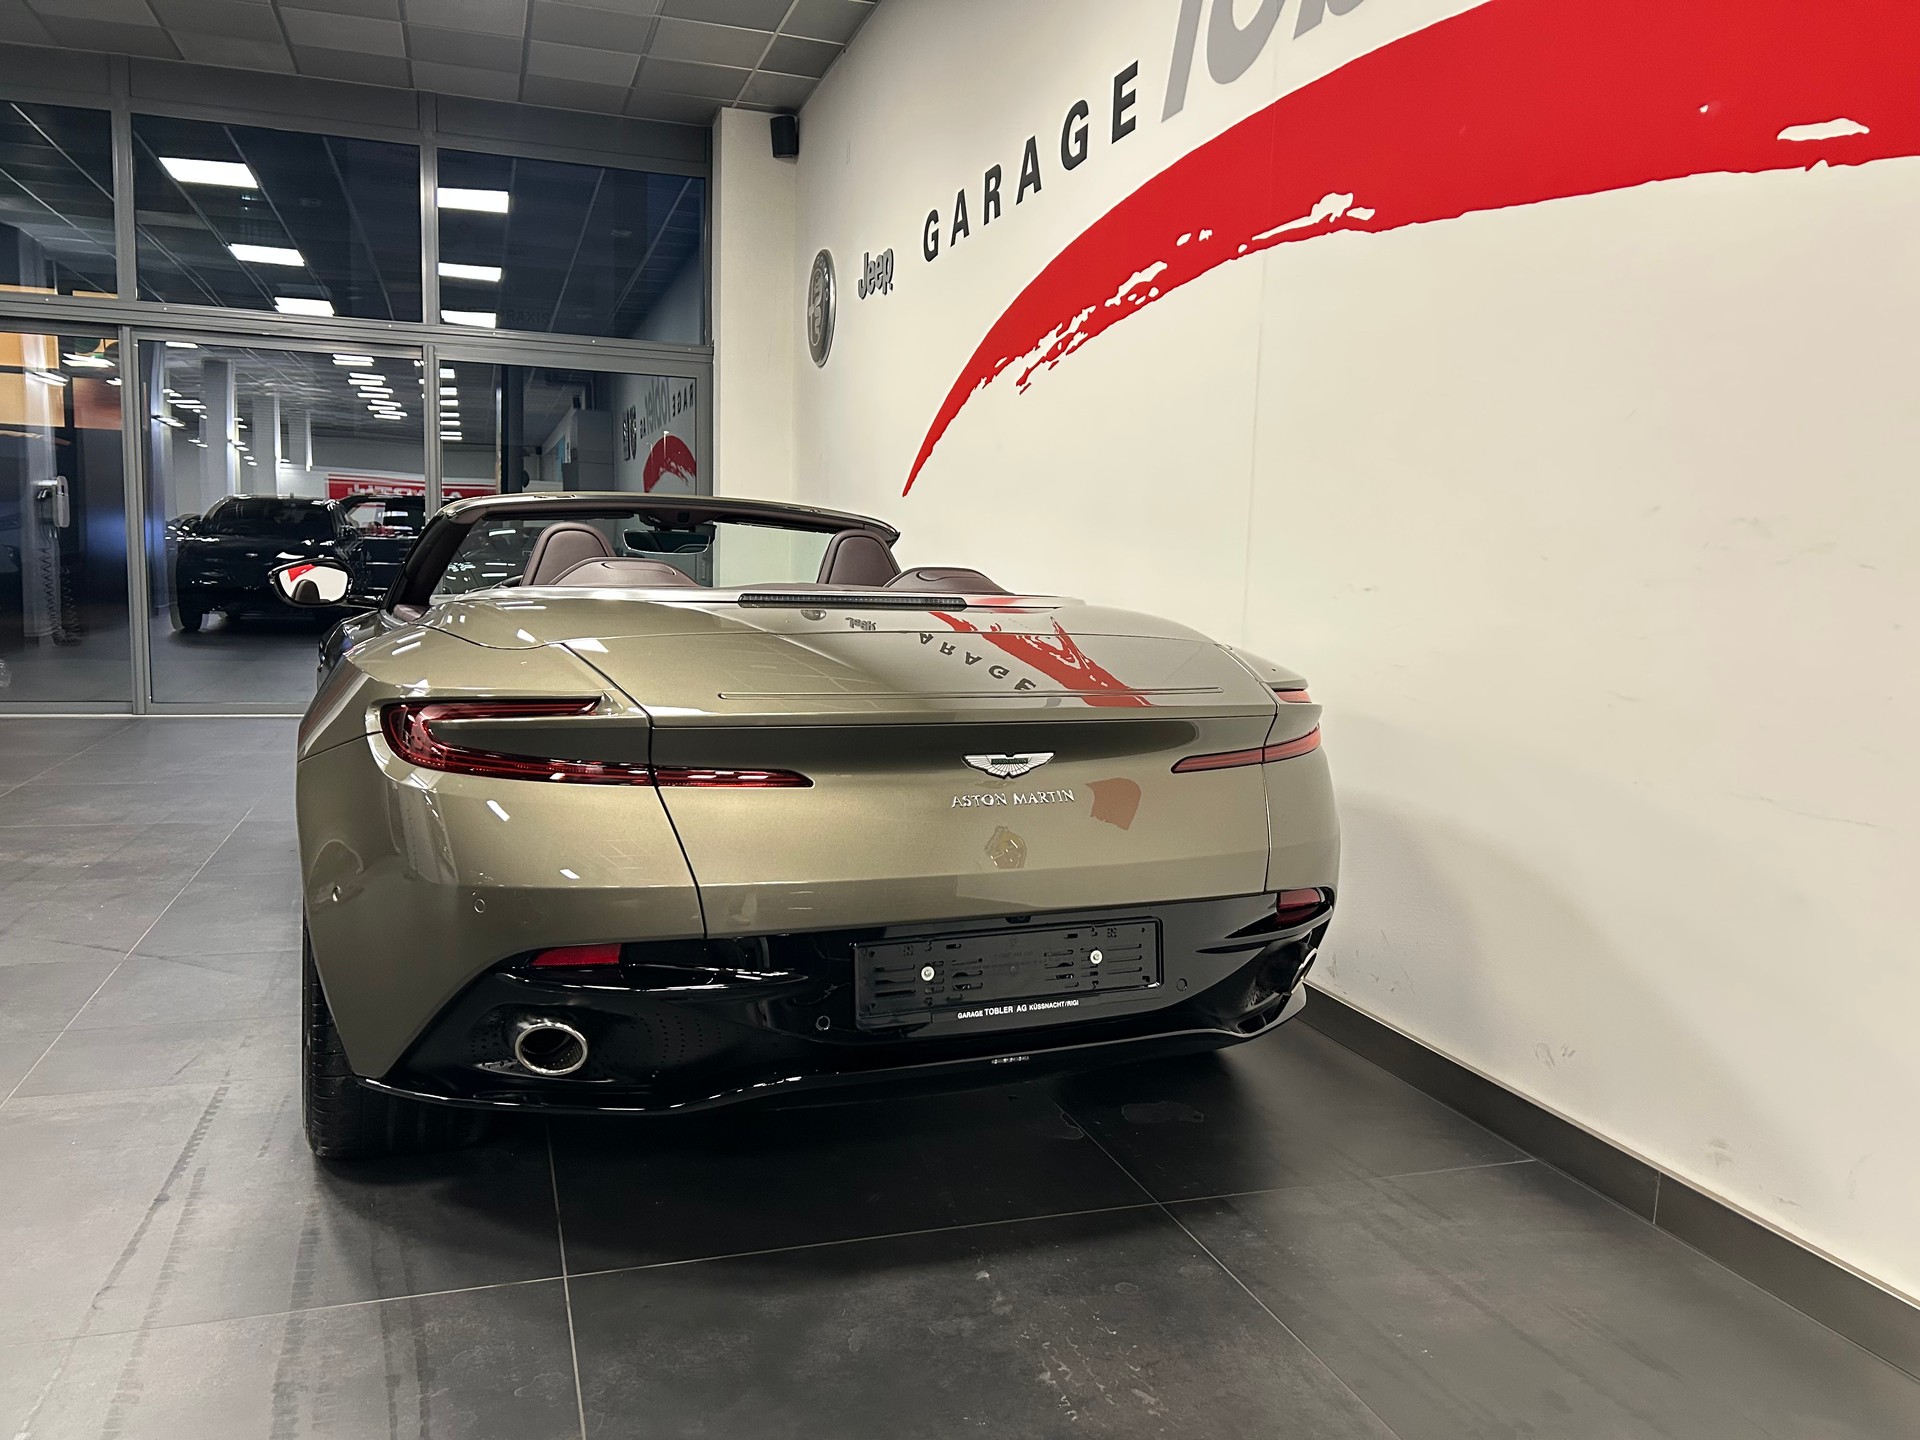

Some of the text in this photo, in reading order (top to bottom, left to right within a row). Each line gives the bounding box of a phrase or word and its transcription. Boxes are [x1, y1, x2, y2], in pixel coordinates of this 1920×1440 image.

[922, 60, 1139, 262] GARAGE
[858, 248, 894, 300] Jeep
[951, 789, 1075, 808] ASTON MARTIN
[957, 1010, 983, 1019] GARAGE
[984, 1005, 1013, 1016] TOBLER
[1016, 1004, 1027, 1013] AG
